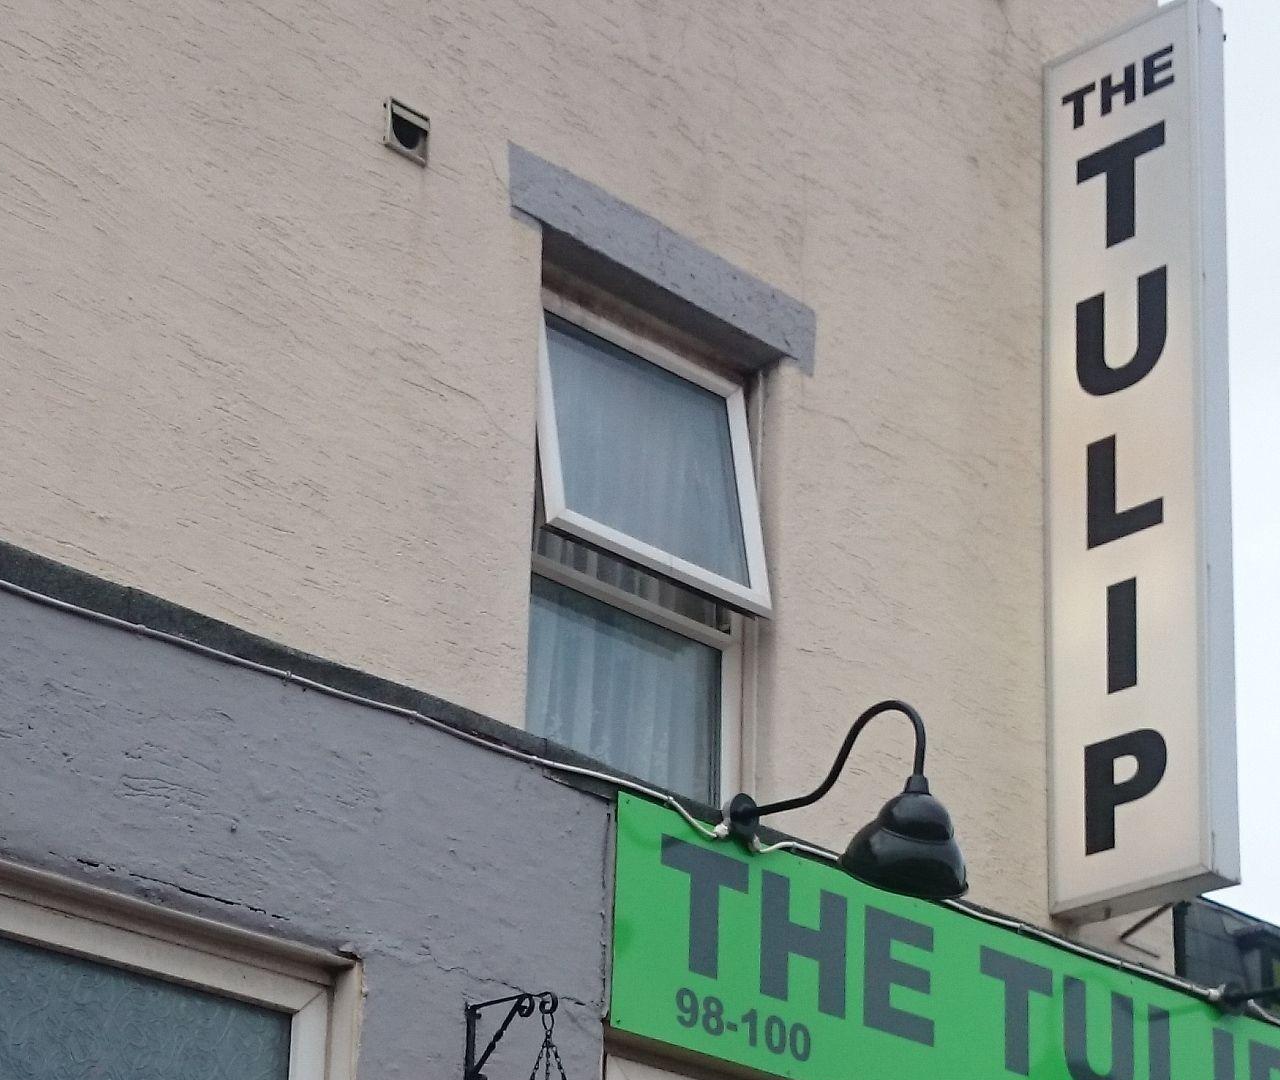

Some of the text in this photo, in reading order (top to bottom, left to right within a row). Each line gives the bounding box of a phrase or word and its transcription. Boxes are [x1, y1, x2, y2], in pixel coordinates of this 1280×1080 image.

[1062, 44, 1175, 130] THE
[1075, 119, 1168, 857] TULIP
[661, 835, 935, 1047] THE
[675, 988, 812, 1062] 98-100
